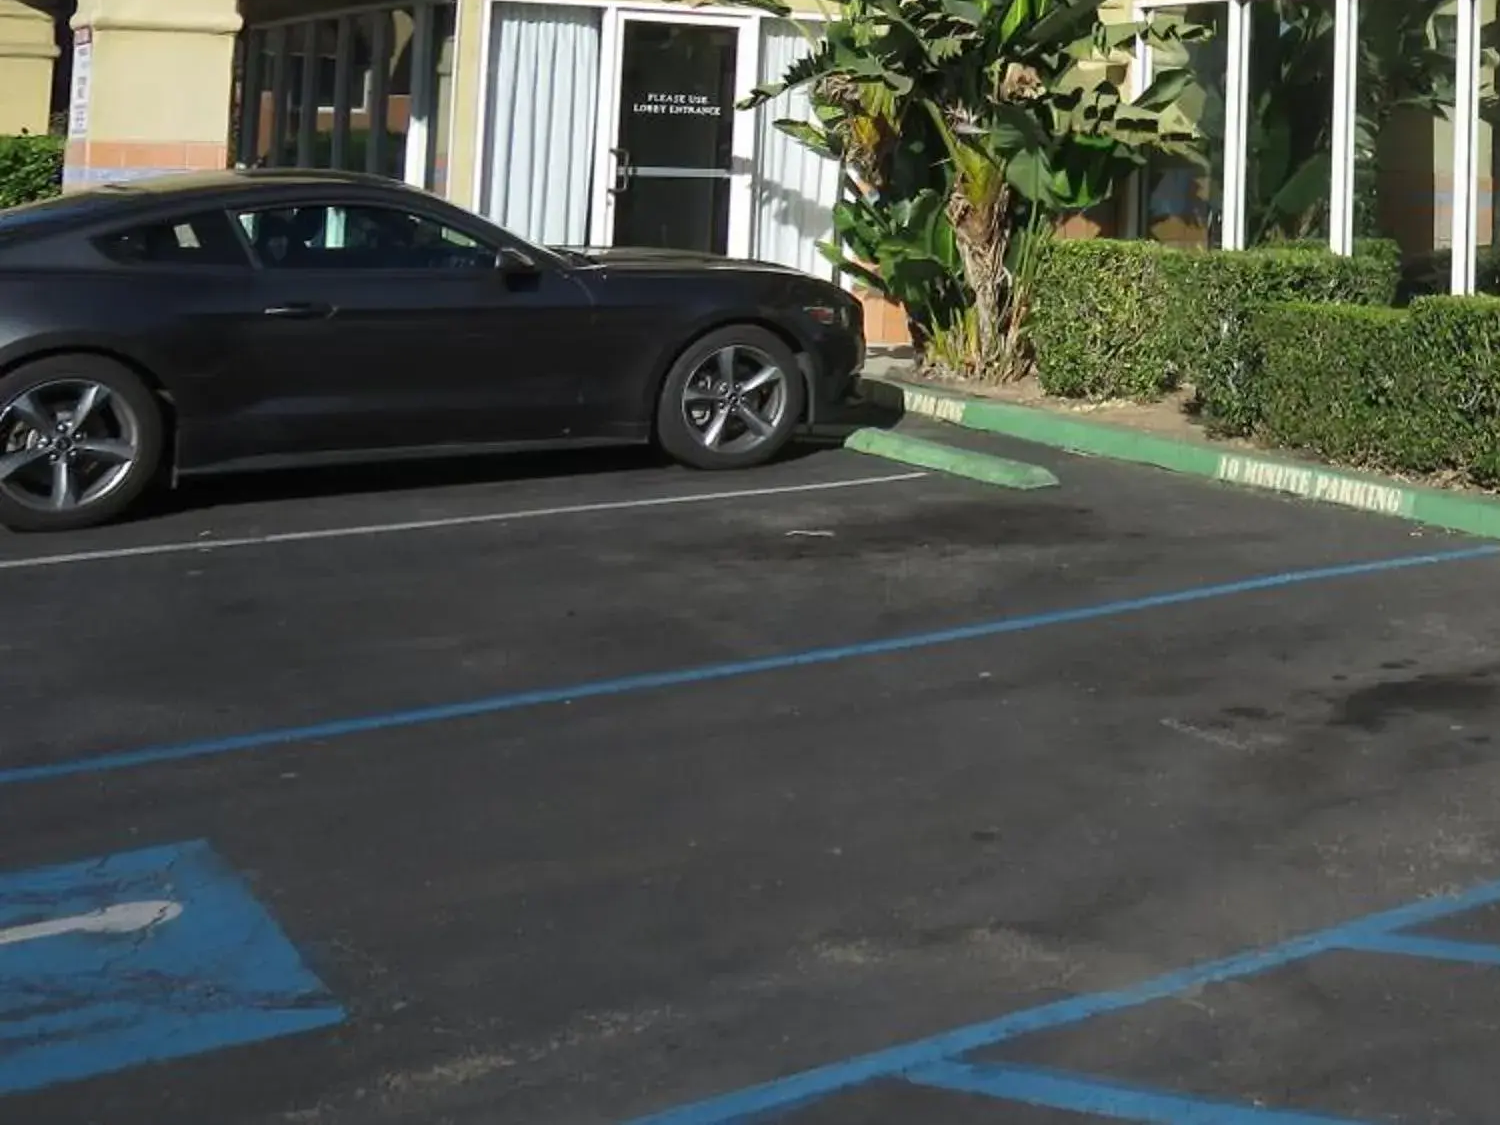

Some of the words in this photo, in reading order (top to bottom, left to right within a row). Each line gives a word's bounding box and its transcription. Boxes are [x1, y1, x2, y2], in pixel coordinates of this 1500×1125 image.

[647, 93, 686, 104] PLEASE
[688, 94, 709, 104] USE
[633, 103, 666, 114] LOBBY
[669, 104, 721, 116] ENTRANCE
[1218, 454, 1240, 480] 10
[1243, 457, 1313, 496] MINUTE
[1314, 472, 1402, 513] PARKING
